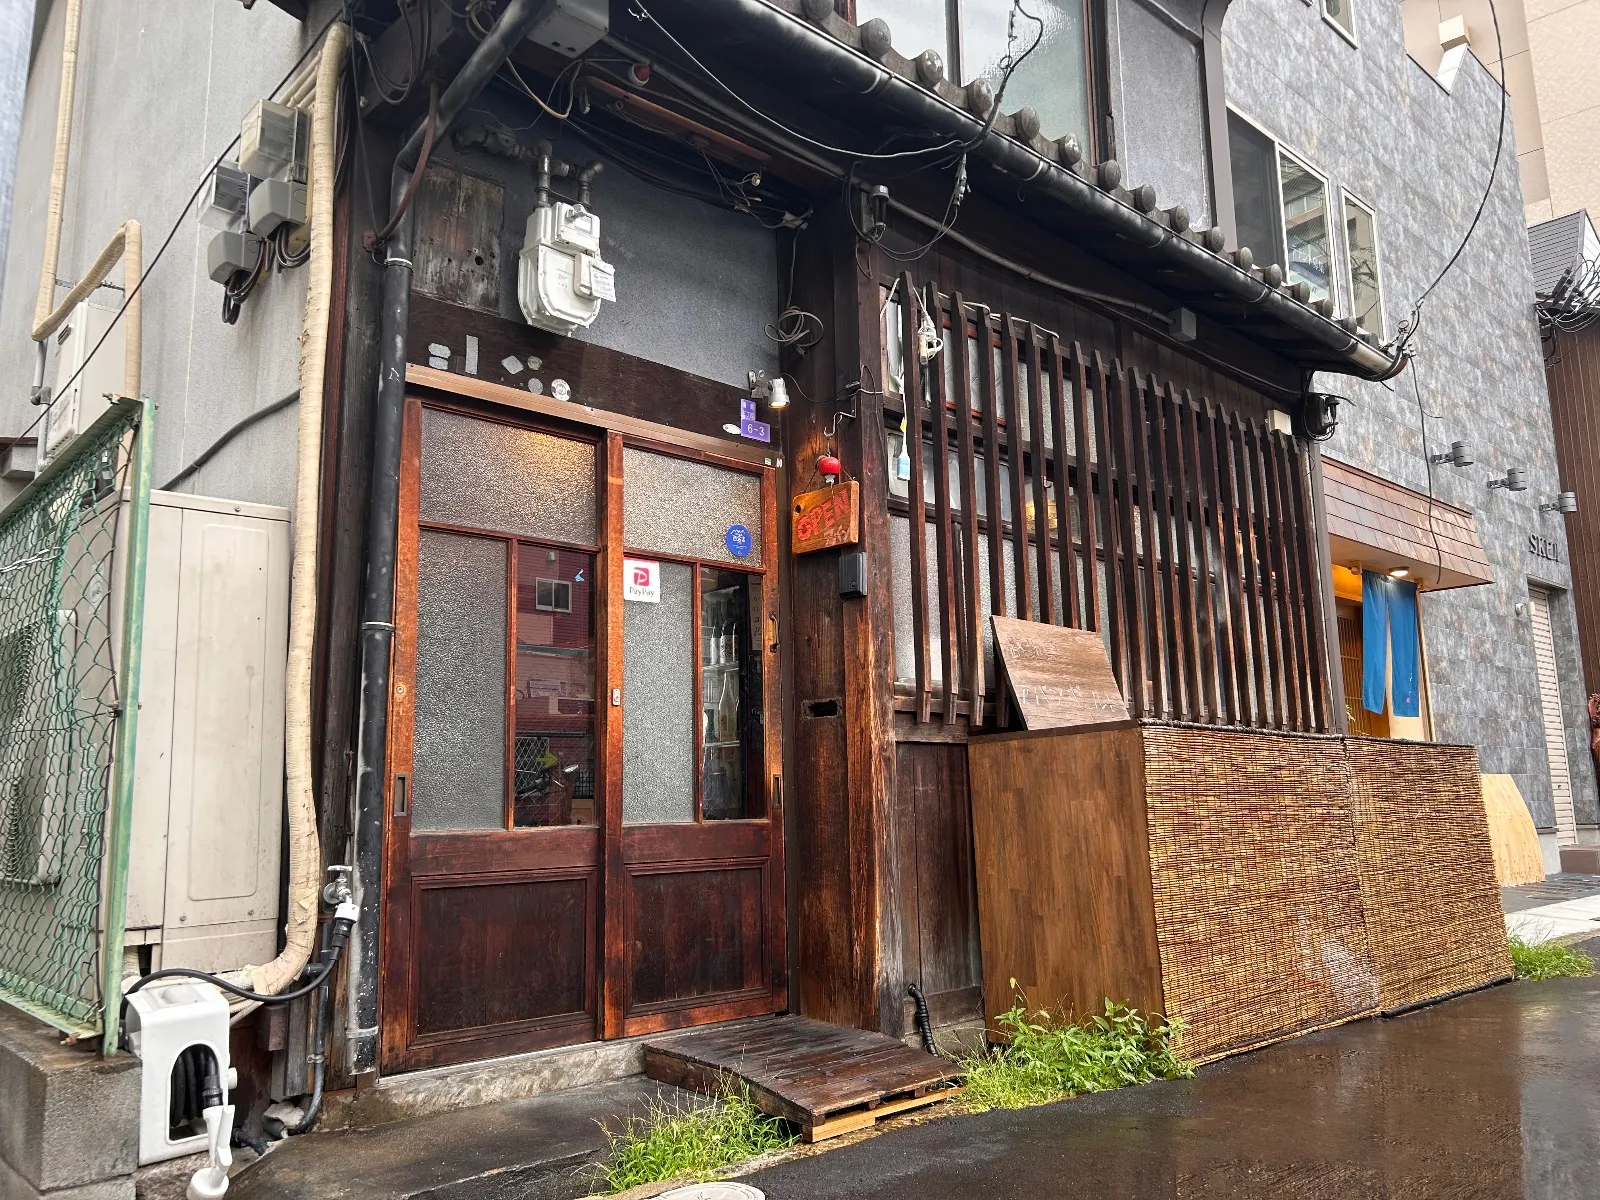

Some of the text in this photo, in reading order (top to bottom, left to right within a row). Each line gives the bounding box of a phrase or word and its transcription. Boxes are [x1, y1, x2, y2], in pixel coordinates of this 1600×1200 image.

[748, 423, 765, 437] 6-3
[797, 488, 850, 540] OPEN
[629, 586, 655, 598] PayPay
